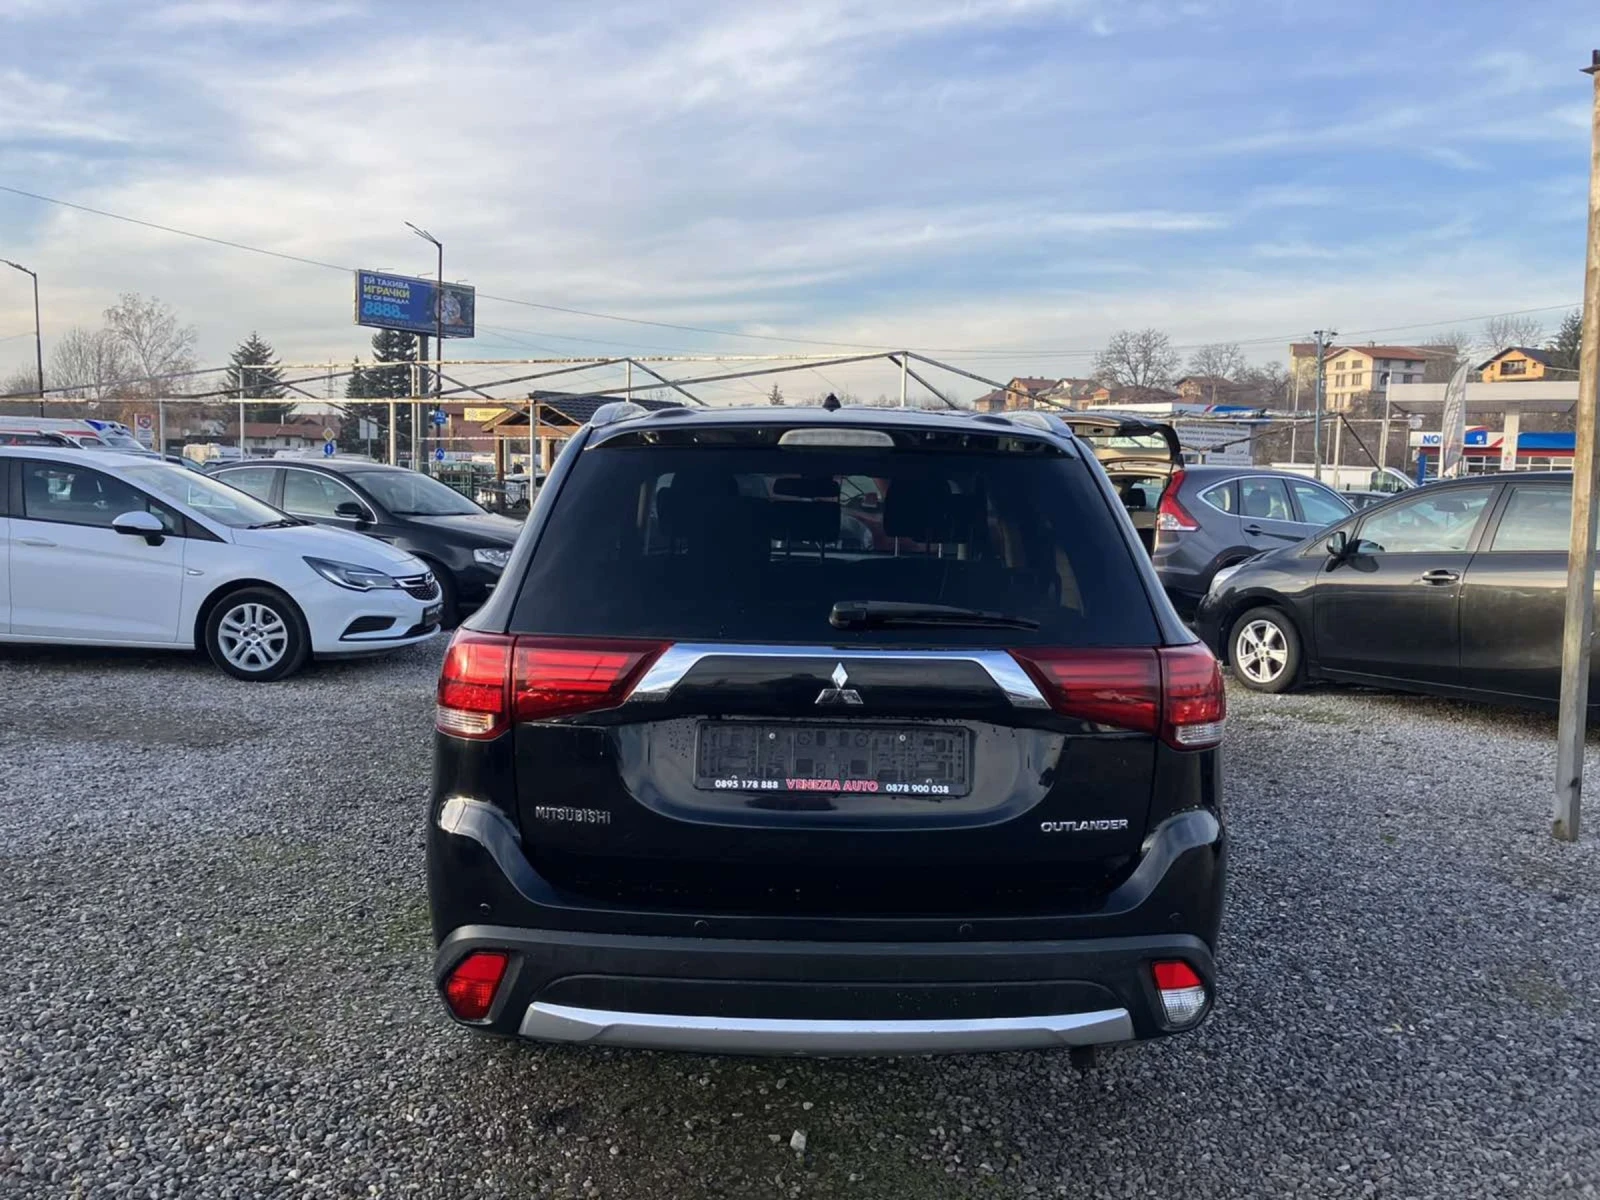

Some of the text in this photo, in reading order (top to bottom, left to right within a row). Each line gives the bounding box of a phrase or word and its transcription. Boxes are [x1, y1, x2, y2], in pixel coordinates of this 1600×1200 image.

[363, 284, 410, 299] ИГРАЧКИ
[714, 778, 950, 794] 0895 178 888 VENEZIA AUTO 0878 900 038
[535, 805, 611, 824] MITSUBISHI
[1040, 818, 1129, 832] OUTLANDER
